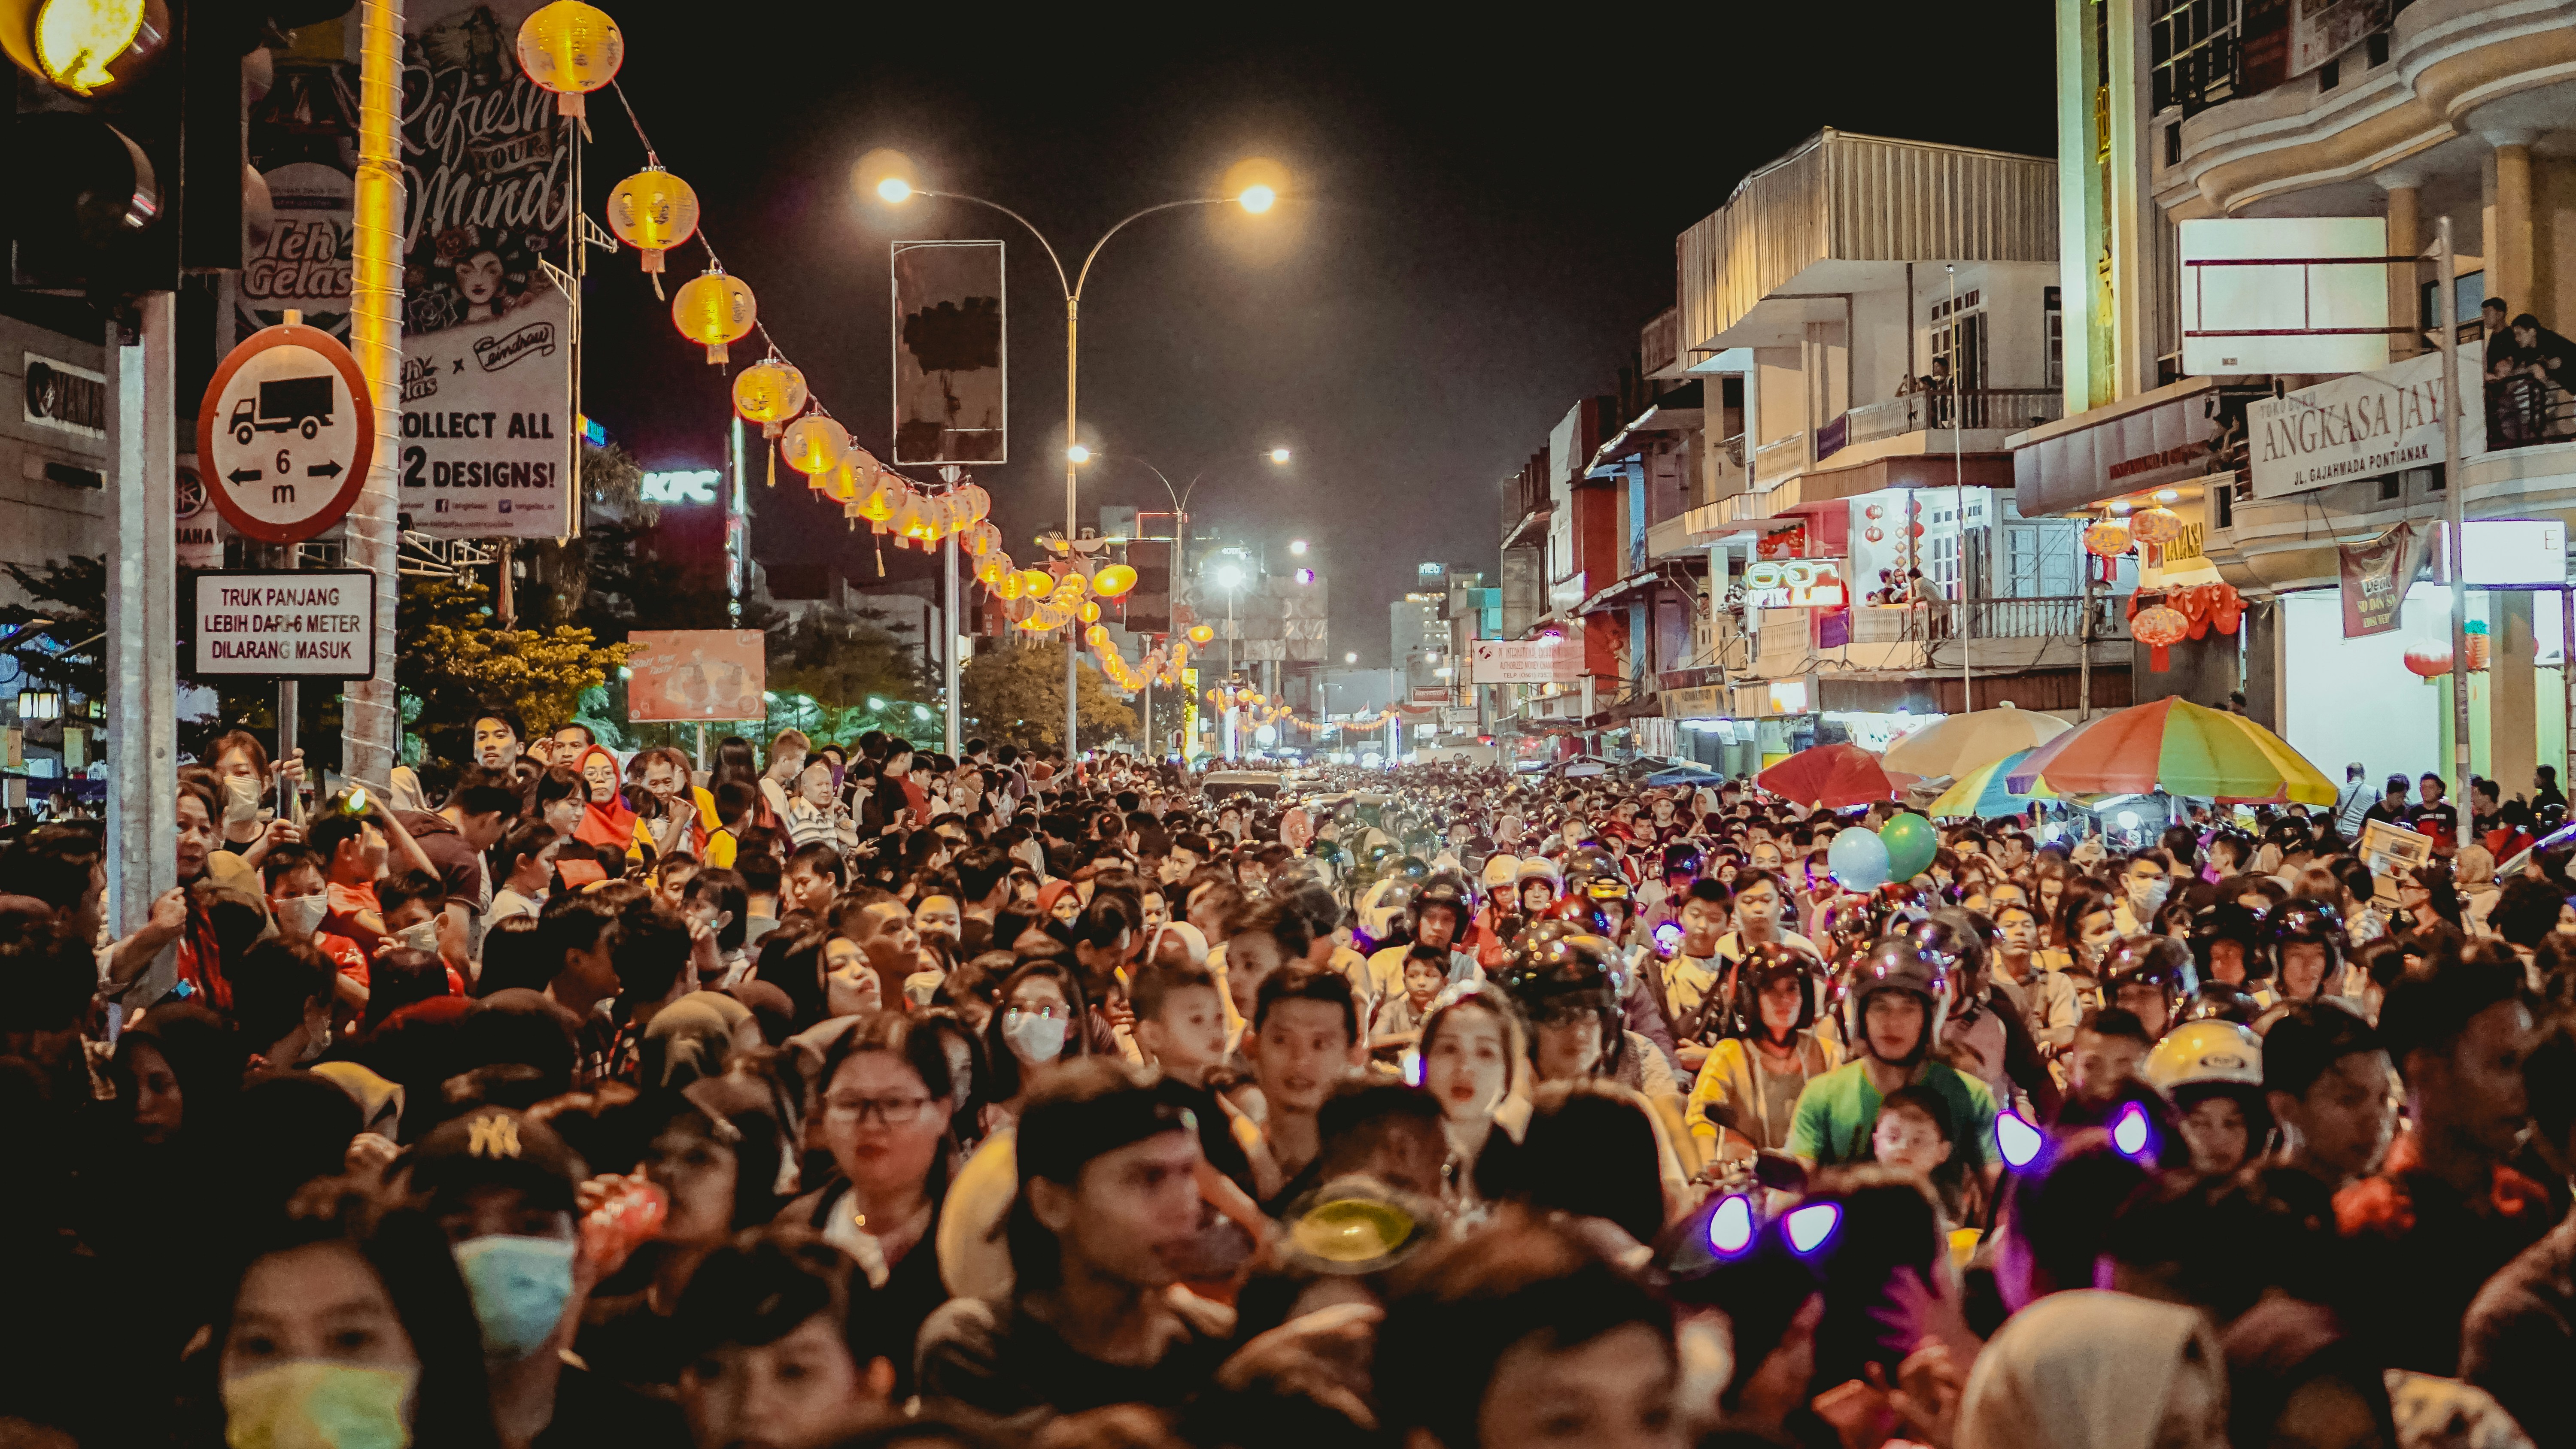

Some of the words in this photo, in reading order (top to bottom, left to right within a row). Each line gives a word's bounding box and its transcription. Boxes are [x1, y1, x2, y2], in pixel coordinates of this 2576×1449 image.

[262, 218, 333, 263] Teh
[241, 256, 353, 300] Gelas
[399, 411, 496, 439] OLLECT
[508, 412, 554, 439] ALL
[2263, 393, 2391, 462] ANGKASA
[276, 449, 290, 474] 6
[398, 445, 427, 488] 2
[432, 461, 555, 488] DESIGNS!
[2294, 470, 2307, 486] JL.
[2309, 458, 2366, 482] GAJAHMADA
[2369, 443, 2429, 469] PONTIANAK
[273, 484, 294, 503] m
[642, 470, 720, 500] KFC
[175, 527, 214, 544] AHA
[221, 588, 262, 606] TRUK
[266, 588, 340, 606] PANJANG
[205, 615, 249, 633] LEBIH
[294, 615, 302, 633] 6
[307, 614, 361, 633] METER
[212, 641, 291, 659] DILARANG
[295, 641, 352, 659] MASUK
